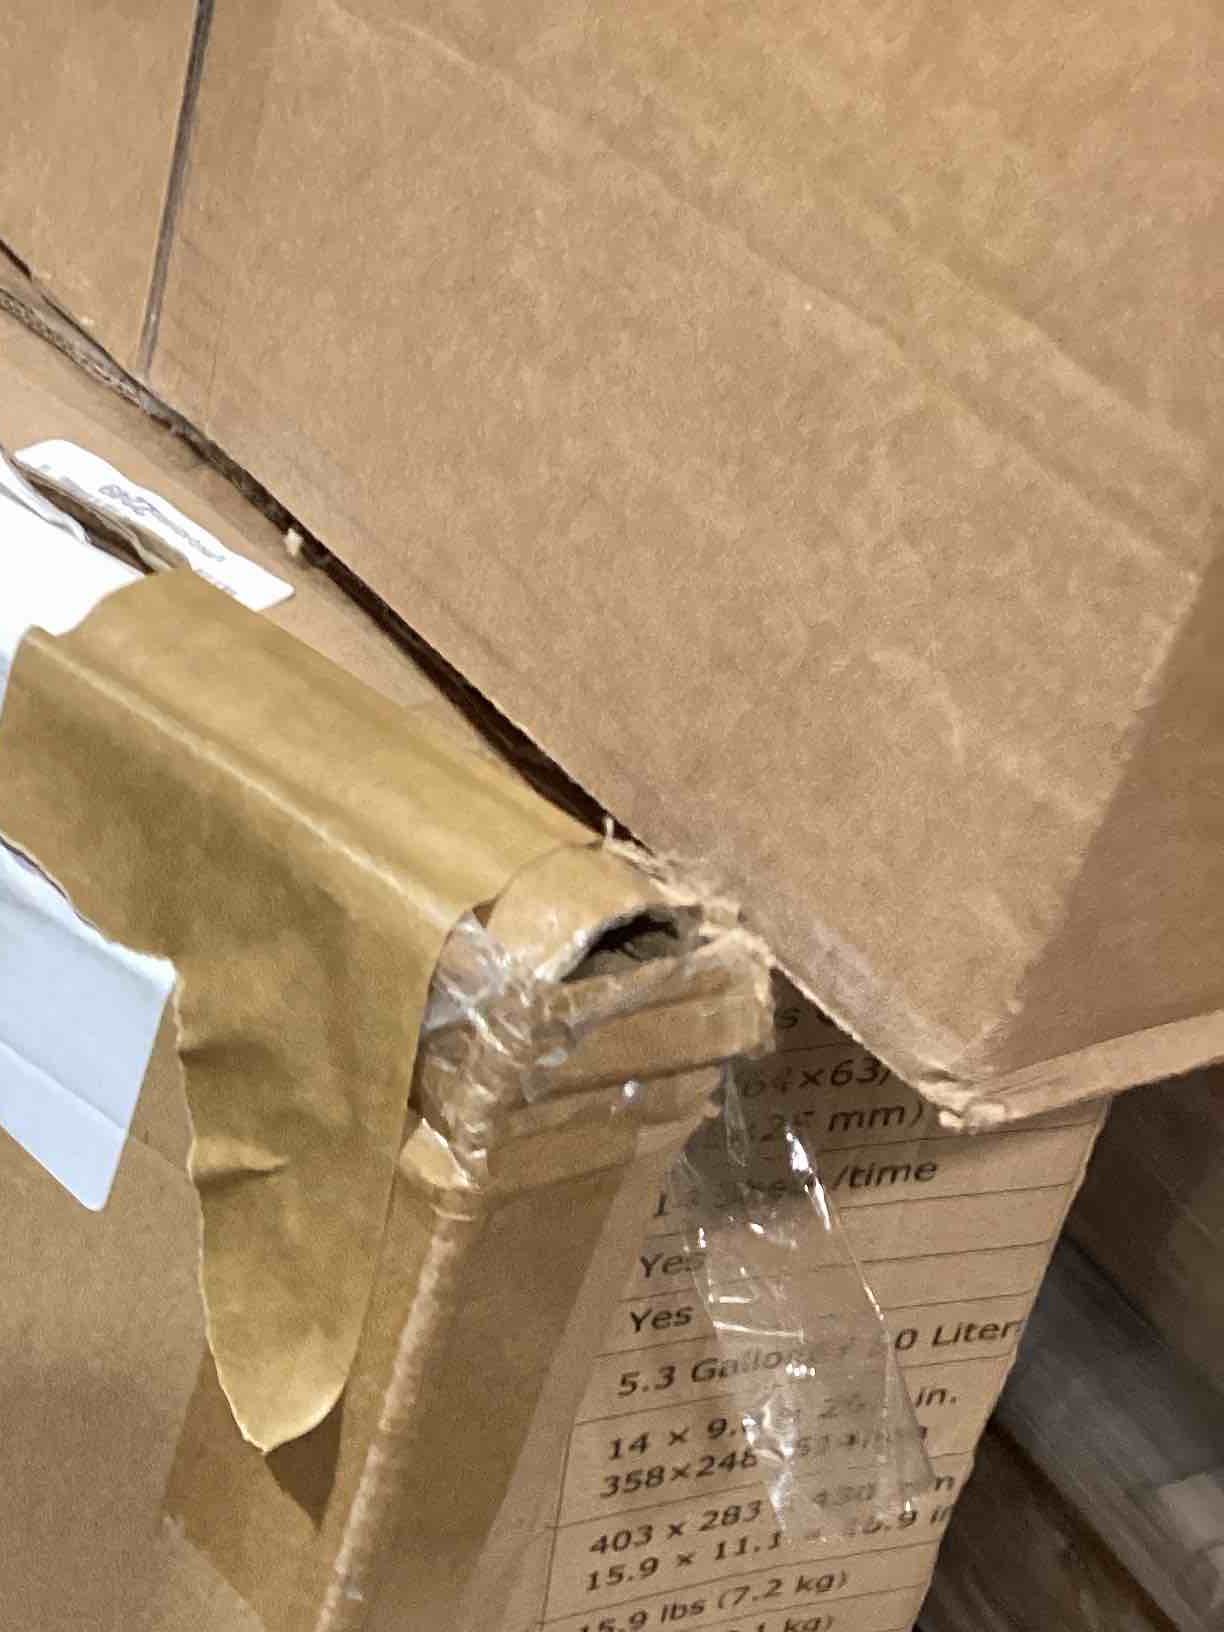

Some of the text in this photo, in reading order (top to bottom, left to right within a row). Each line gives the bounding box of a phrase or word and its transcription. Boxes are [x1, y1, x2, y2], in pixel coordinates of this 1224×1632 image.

[639, 1250, 706, 1278] Yes
[629, 1306, 693, 1333] Yes
[617, 1366, 675, 1397] 5.3
[609, 1430, 649, 1460] 14
[589, 1525, 653, 1554] 403
[699, 1500, 761, 1531] 283
[586, 1557, 659, 1590] 15.9
[715, 1532, 781, 1561] 11.1
[660, 1602, 705, 1623] lbs
[717, 1578, 782, 1609] (7.2
[795, 1569, 847, 1593] kg)
